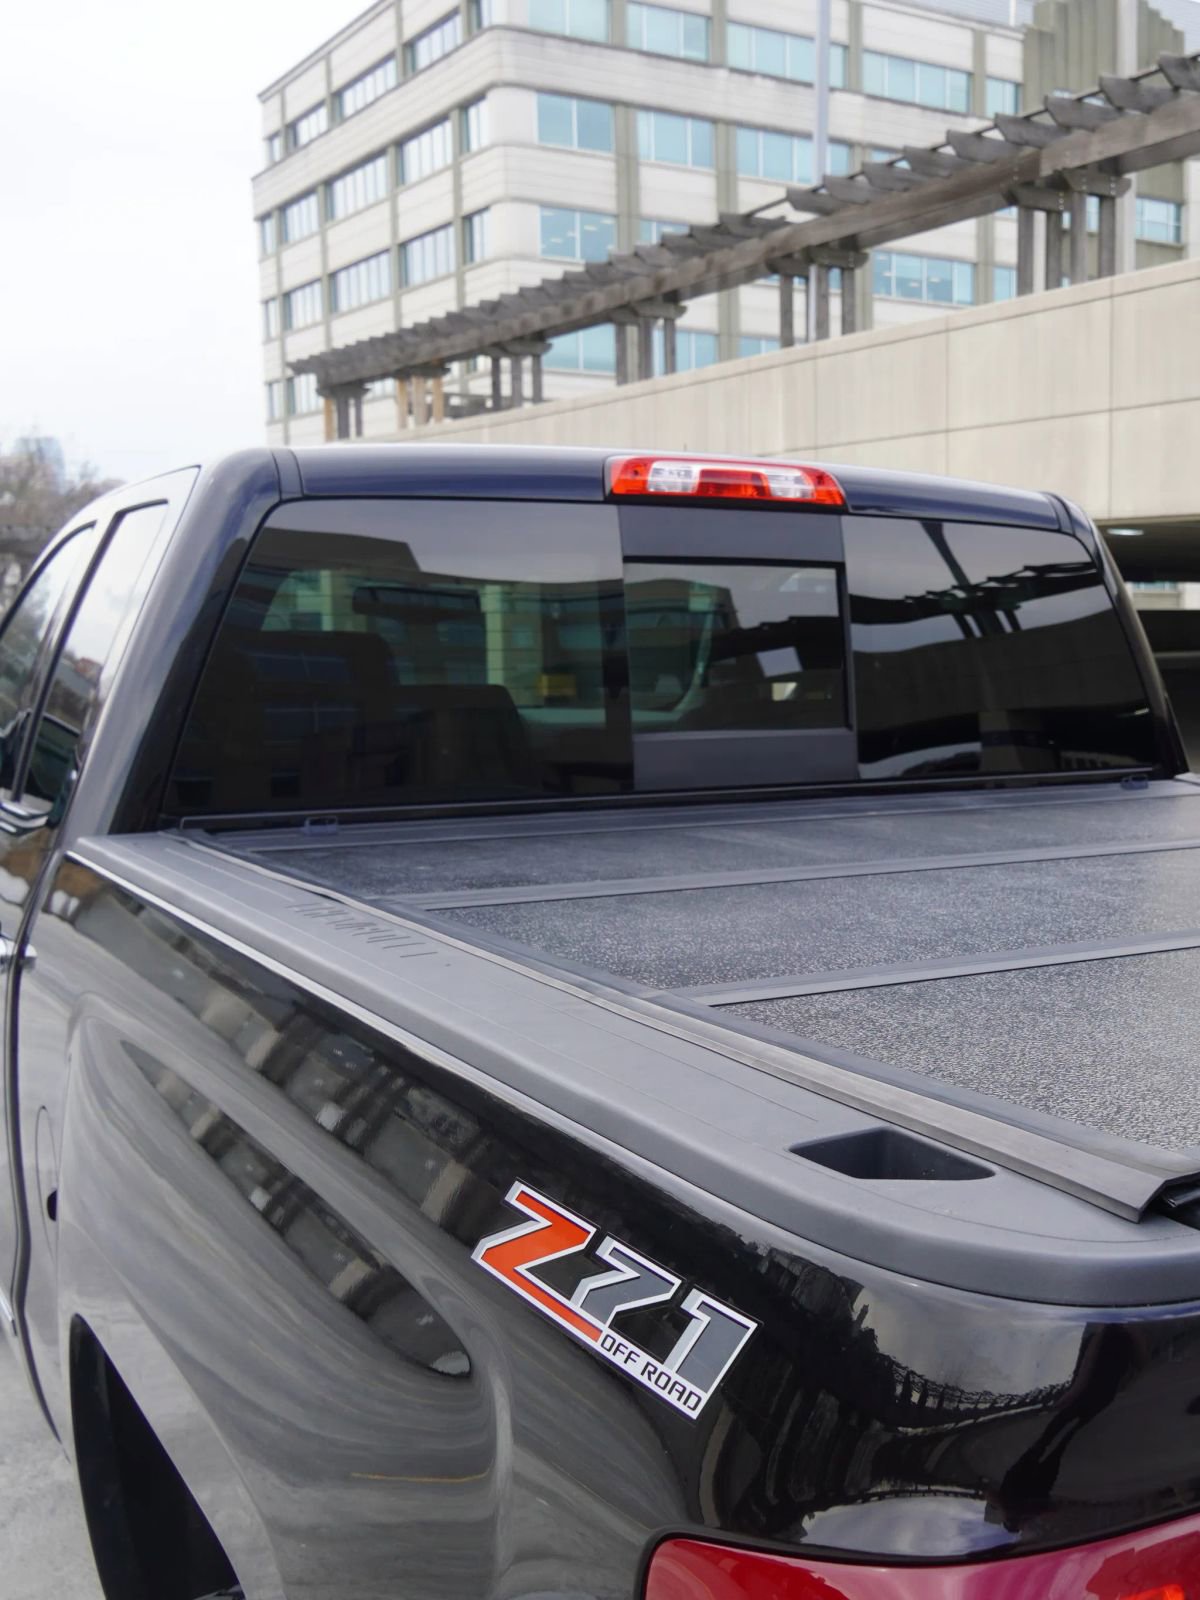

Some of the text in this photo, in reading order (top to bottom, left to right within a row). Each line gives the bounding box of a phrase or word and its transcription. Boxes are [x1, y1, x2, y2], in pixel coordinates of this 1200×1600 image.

[471, 1180, 758, 1398] Z71
[600, 1334, 702, 1411] OFF ROAD
